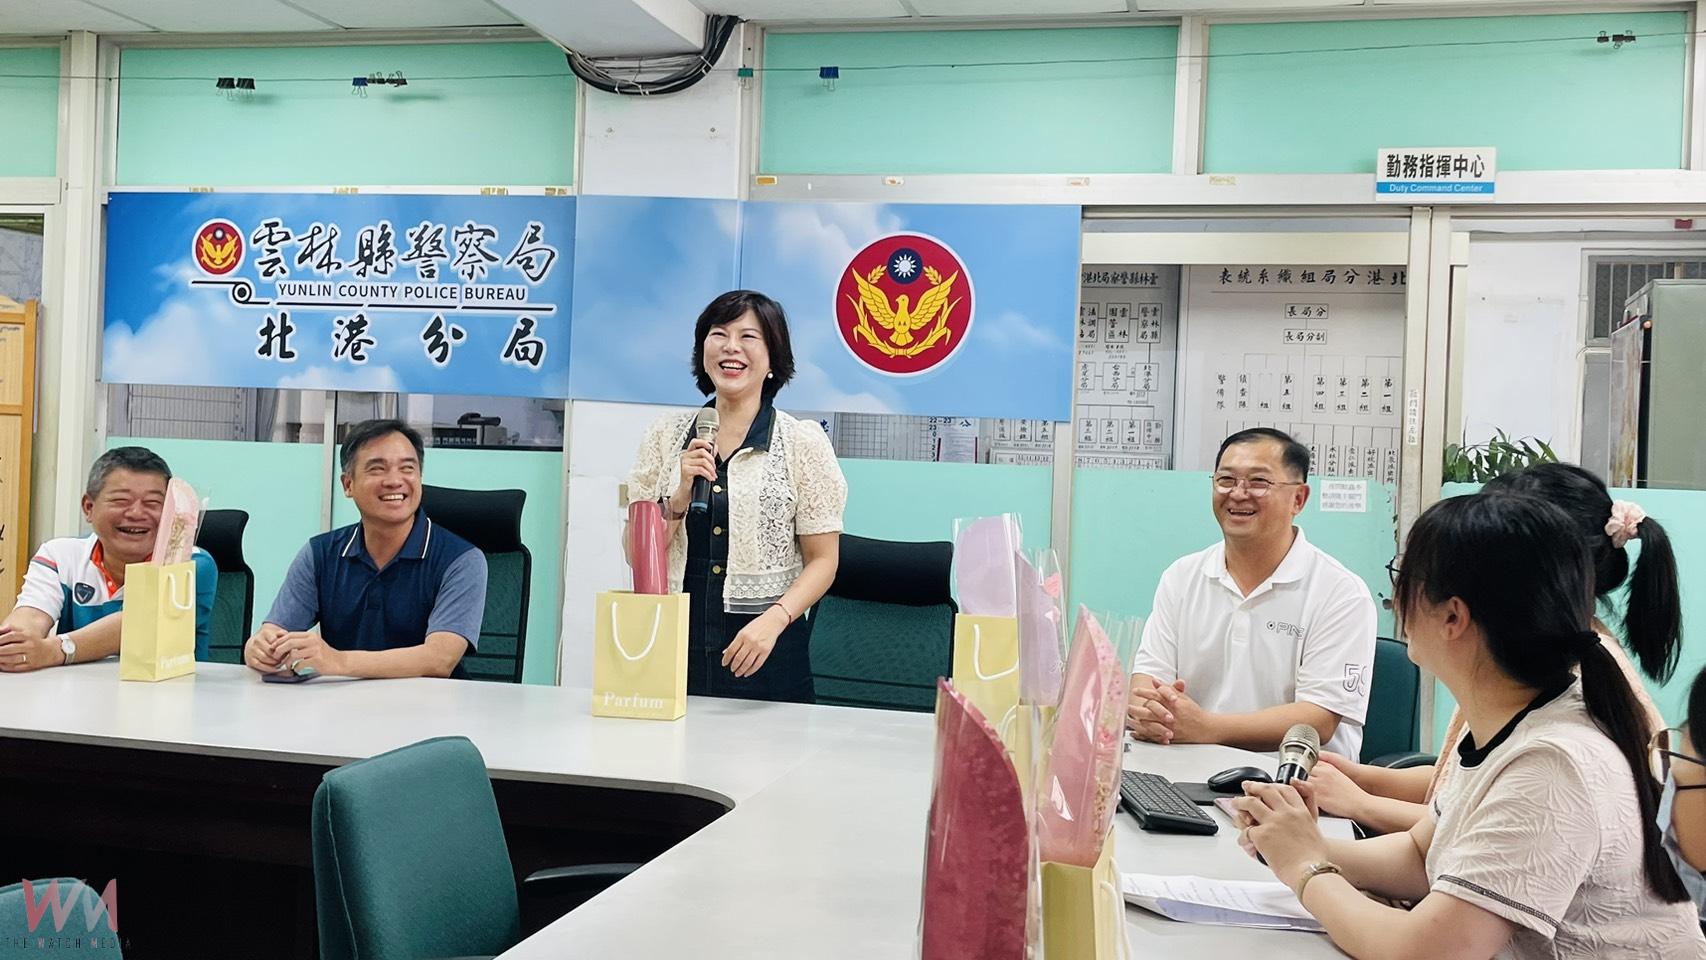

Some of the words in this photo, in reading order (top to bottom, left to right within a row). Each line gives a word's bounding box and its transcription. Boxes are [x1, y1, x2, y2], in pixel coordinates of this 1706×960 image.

[1386, 154, 1485, 178] 勤務指揮中心
[1389, 184, 1408, 193] Duty
[1410, 184, 1452, 192] Command
[1454, 184, 1483, 192] Center
[253, 221, 556, 282] 雲林縣警察局
[279, 283, 332, 297] YUNLIN
[338, 284, 398, 298] COUNTY
[404, 286, 458, 299] POLICE
[464, 287, 526, 300] BUREAU
[258, 312, 544, 366] 北港分局
[1360, 378, 1370, 412] 第二組
[1381, 378, 1393, 413] 第一組
[603, 690, 664, 709] Parfum
